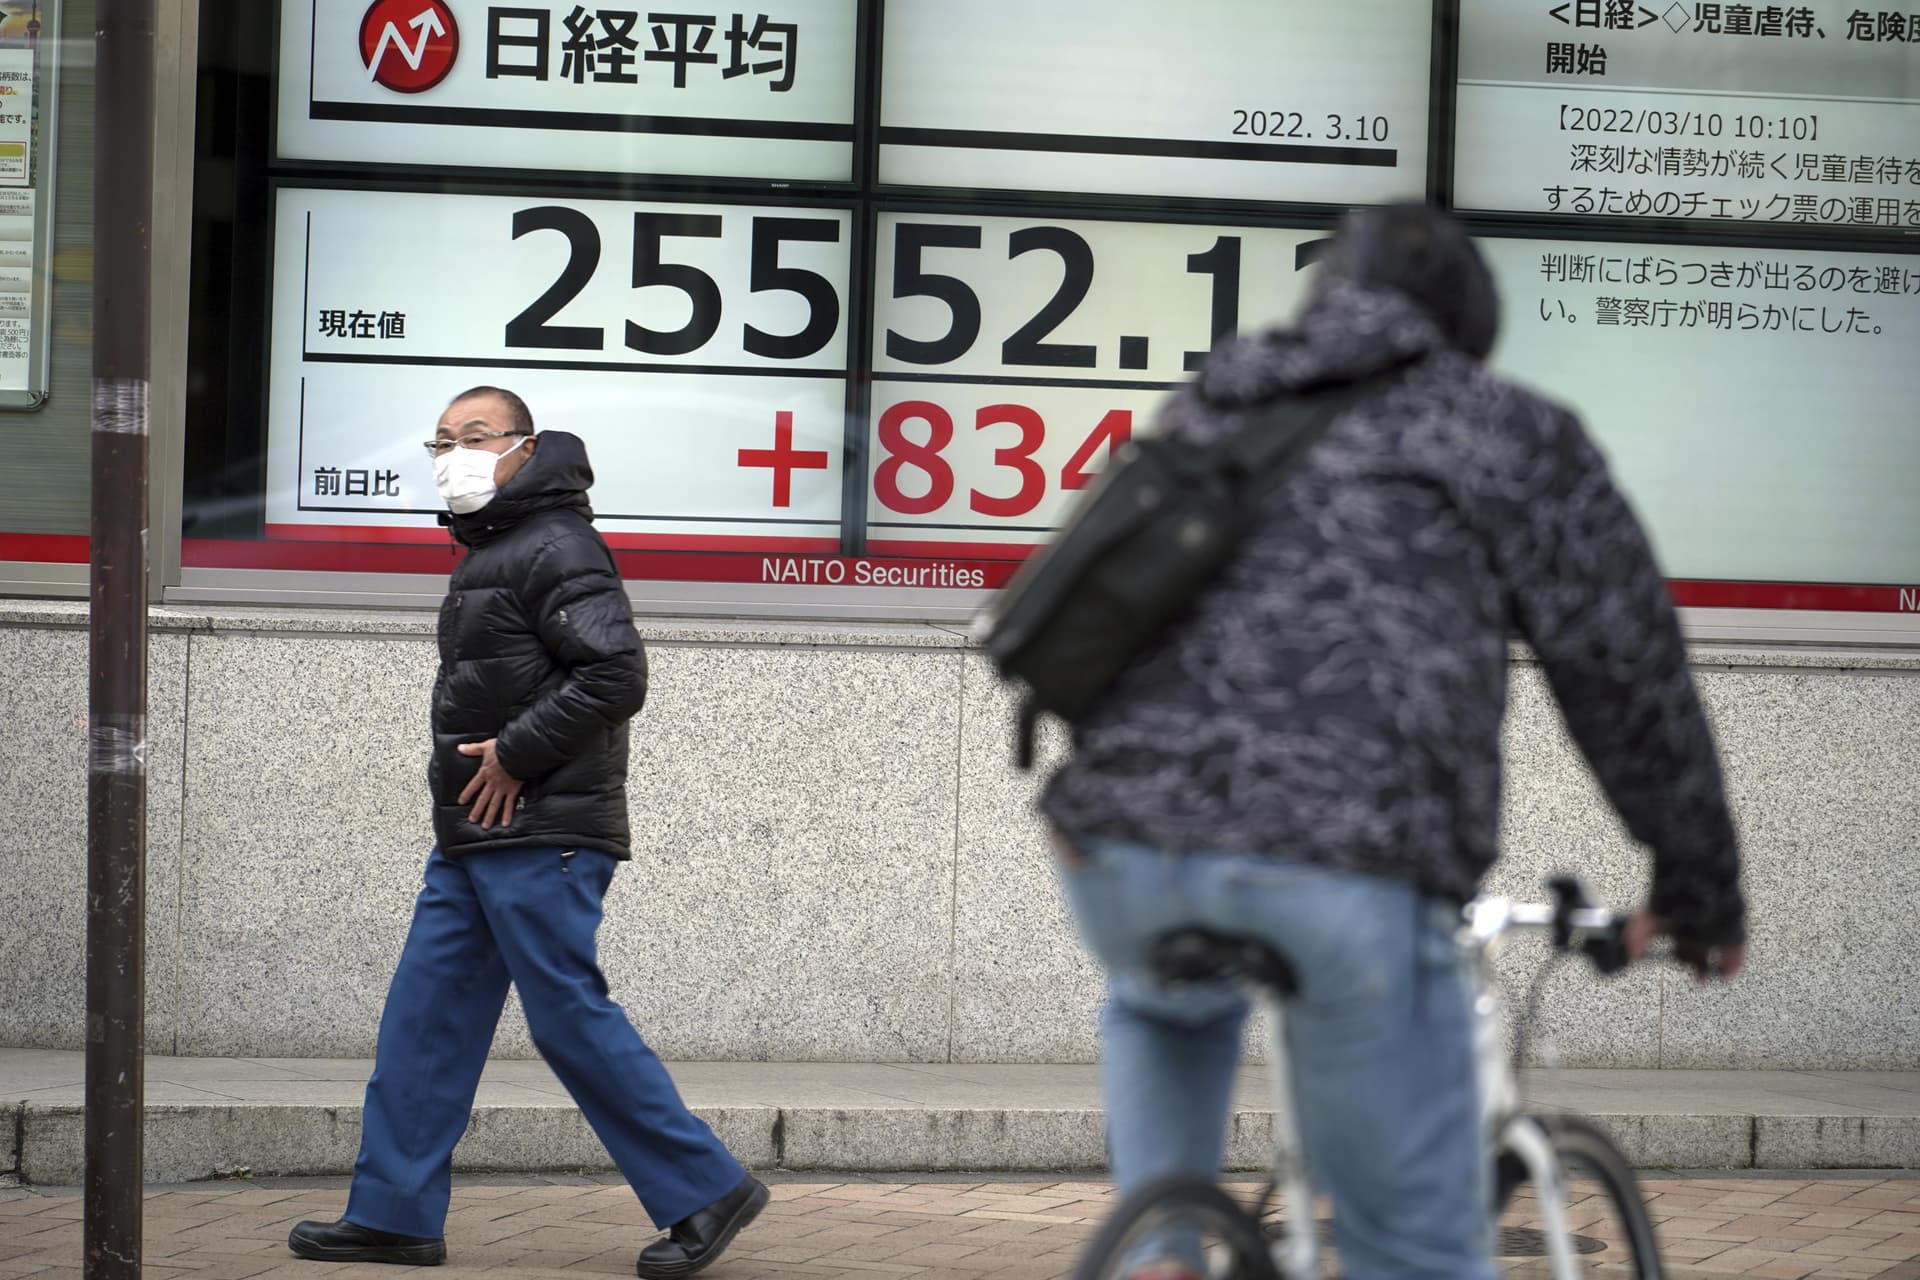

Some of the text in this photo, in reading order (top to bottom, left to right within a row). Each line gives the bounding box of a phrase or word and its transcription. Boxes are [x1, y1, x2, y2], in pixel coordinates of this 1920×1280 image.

[485, 5, 798, 92] 日経平均
[1546, 42, 1607, 76] 開始
[0, 72, 31, 82] 柄数は、
[1542, 185, 1920, 226] するためのチェック票の運用を
[505, 205, 1334, 371] 25552.1
[318, 309, 406, 340] 現在値
[1540, 297, 1882, 335] い。警察庁が明らかにした。
[314, 466, 400, 497] 前日比
[762, 558, 985, 587] NAITO Securities
